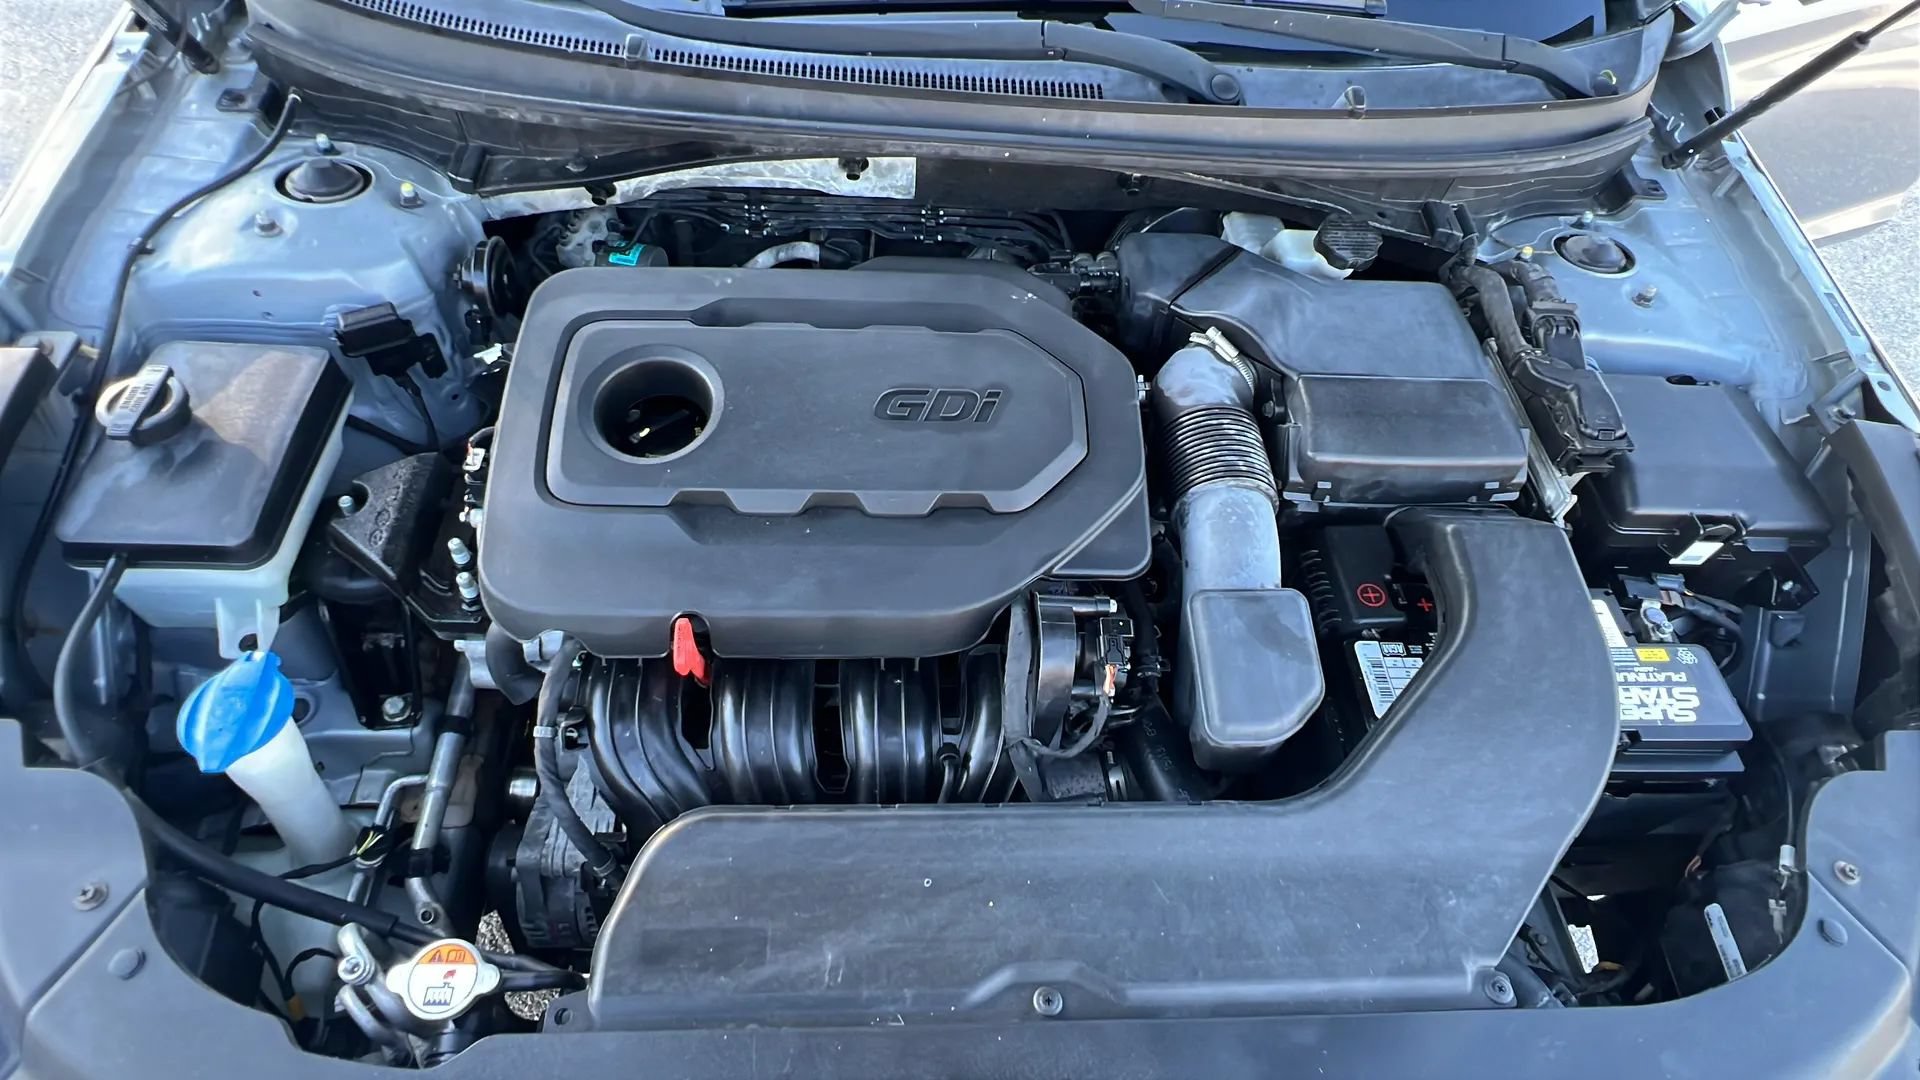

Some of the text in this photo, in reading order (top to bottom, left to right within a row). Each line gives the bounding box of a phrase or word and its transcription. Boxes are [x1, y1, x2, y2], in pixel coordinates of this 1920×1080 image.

[873, 387, 1003, 423] GDi
[1616, 671, 1688, 682] PLATINU
[1618, 686, 1700, 707] STAR
[1619, 704, 1697, 722] SUPE
